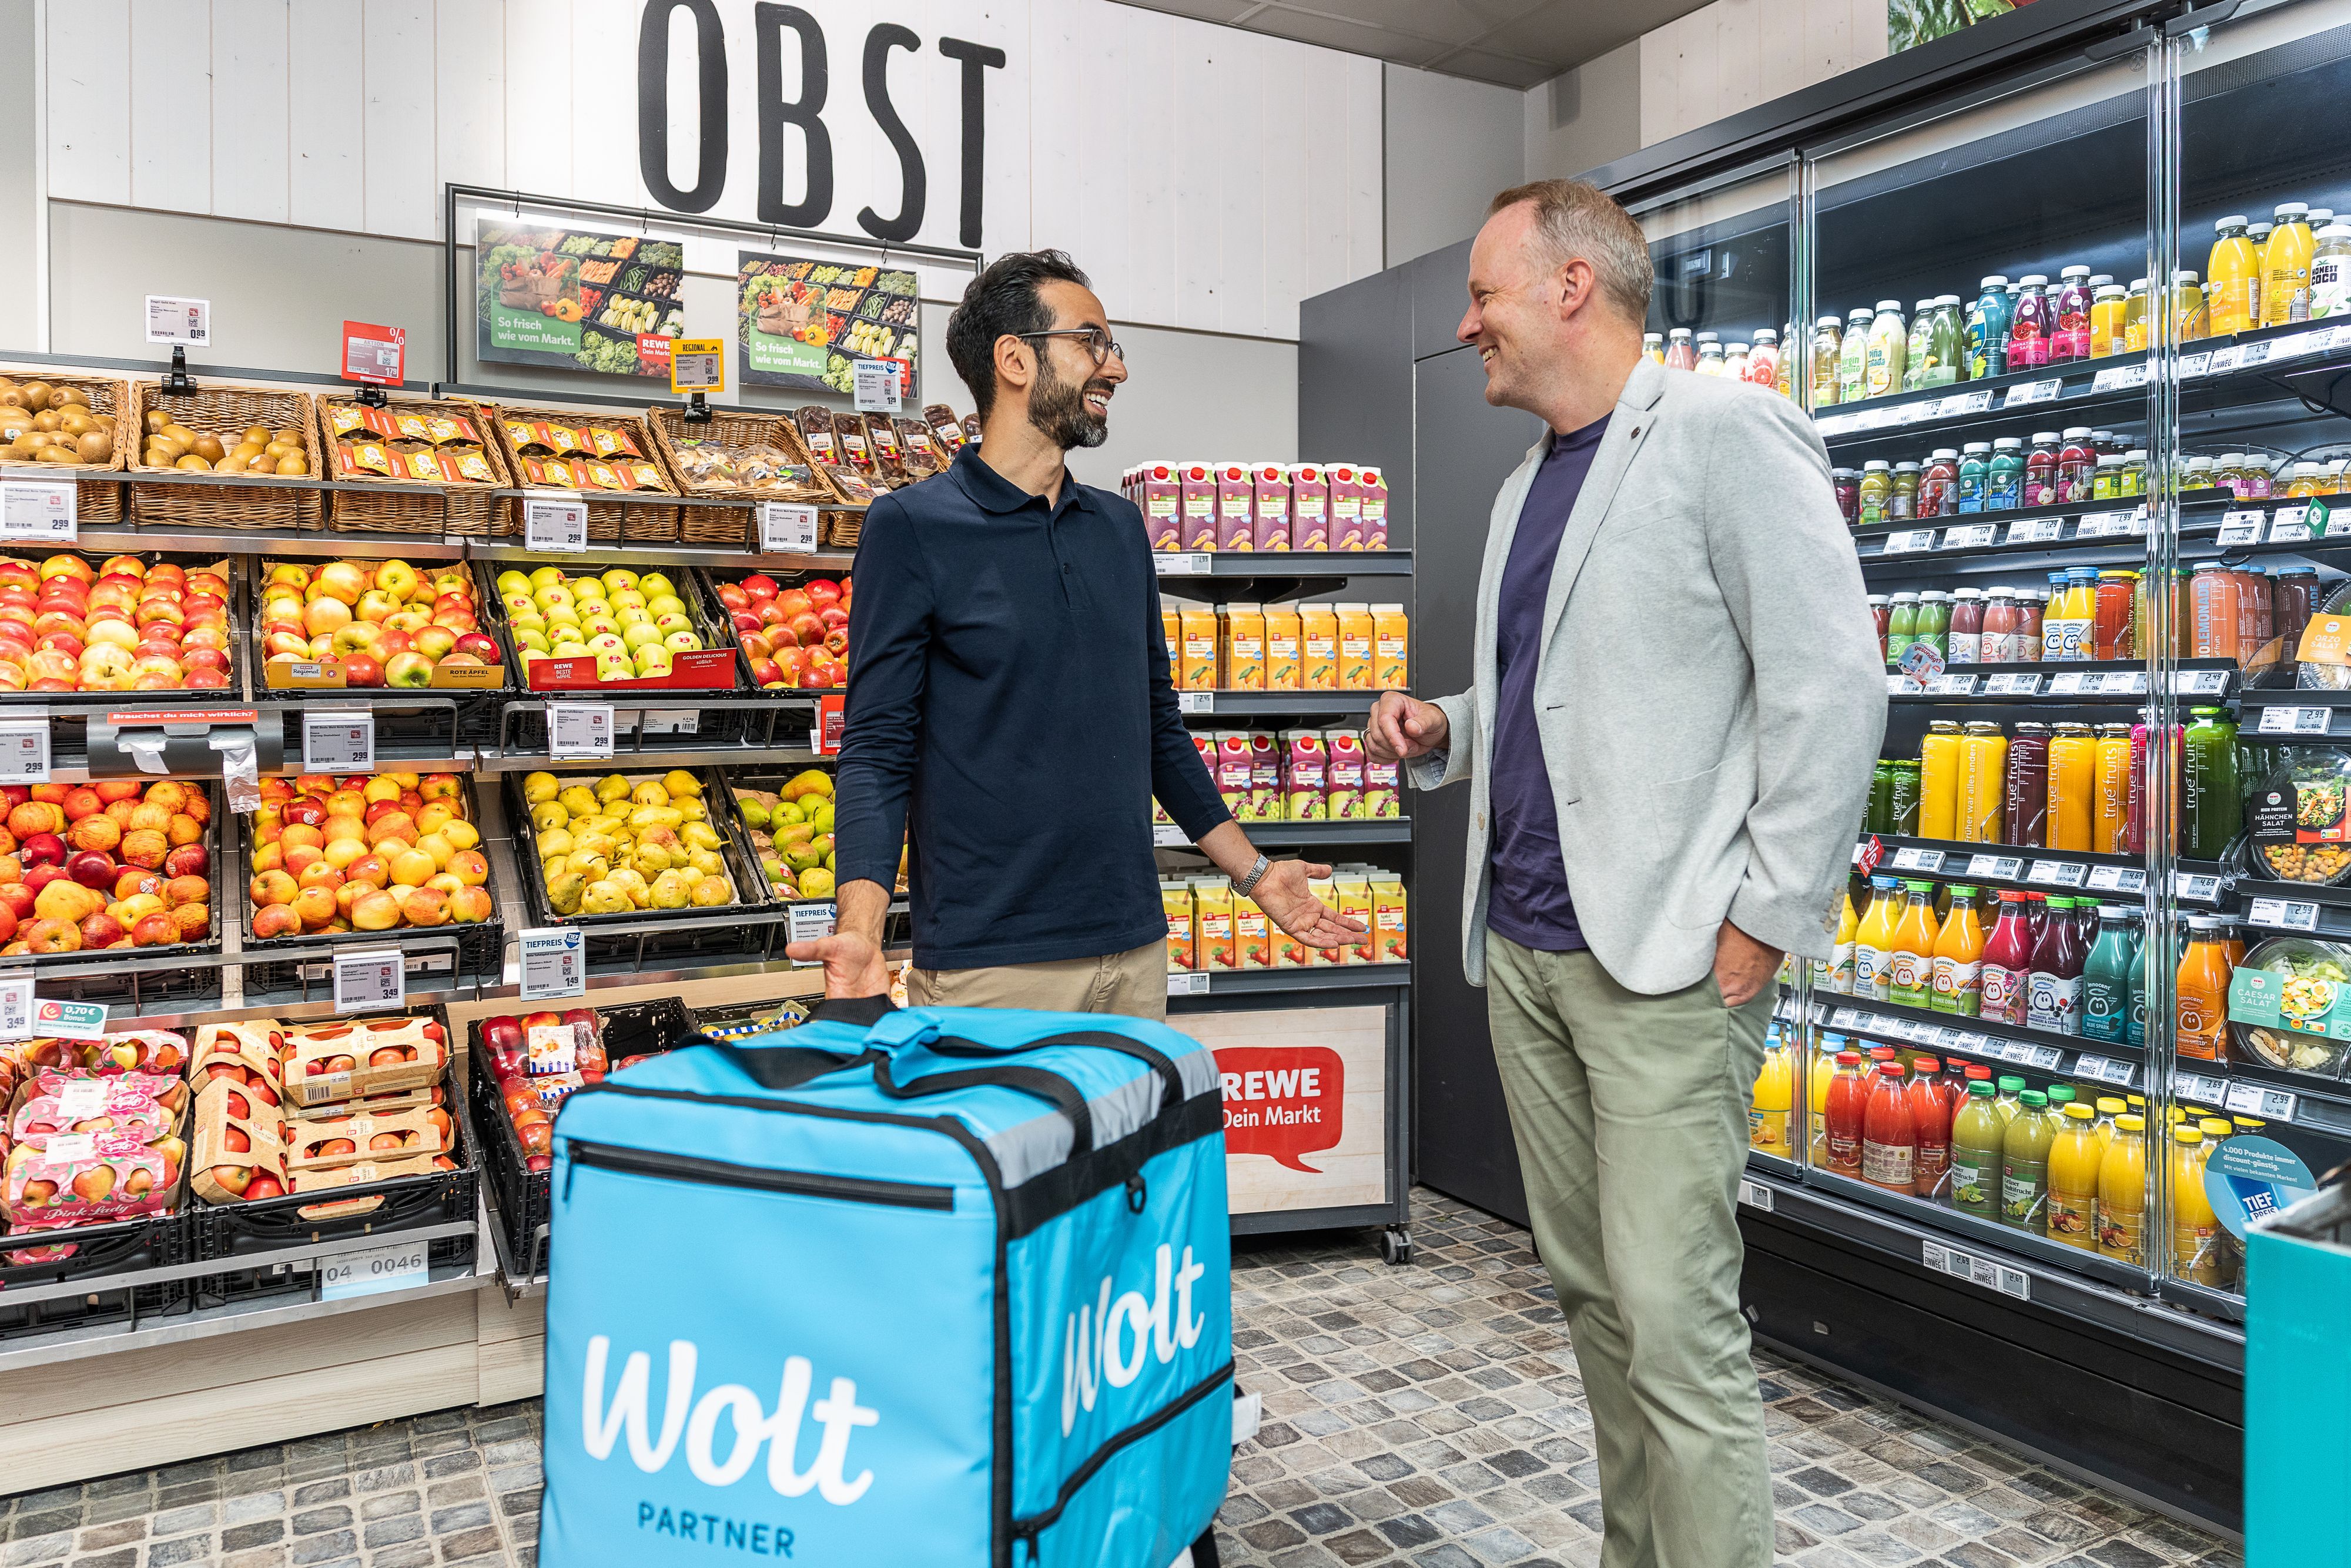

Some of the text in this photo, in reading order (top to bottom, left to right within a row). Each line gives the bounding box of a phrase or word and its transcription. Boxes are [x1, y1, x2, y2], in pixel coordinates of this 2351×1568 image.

[638, 0, 1006, 249] OBST
[2312, 265, 2338, 275] HONEST
[2312, 273, 2337, 286] COCO
[498, 317, 542, 330] So frisch
[190, 329, 205, 339] 0.89
[498, 330, 574, 346] wie vom Markt.
[642, 339, 671, 349] REWE
[755, 341, 793, 354] So frisch
[2256, 343, 2270, 353] 1.79
[1868, 349, 1882, 361] Piña
[755, 354, 822, 368] wie vom Markt.
[2212, 359, 2232, 370] EINWEG
[1841, 366, 1860, 375] Mojito
[2093, 382, 2111, 392] EINWEG
[2119, 514, 2131, 522] 1.99
[52, 519, 69, 530] 2.99
[568, 534, 581, 543] 2.99
[801, 535, 812, 544] 2.99
[2310, 641, 2340, 649] SALAT
[2307, 710, 2324, 720] 2.99
[595, 737, 608, 747] 2.99
[353, 752, 367, 762] 2.99
[26, 763, 42, 773] 2.99
[2185, 735, 2196, 809] true fruits
[2008, 745, 2018, 812] true fruits
[2048, 745, 2058, 814] true fruits
[2103, 747, 2117, 818] true fruits
[1859, 857, 1871, 875] Aktion
[2201, 879, 2216, 887] 4.69
[526, 939, 562, 948] TIEFPREIS
[565, 977, 578, 987] 1.49
[2034, 976, 2056, 984] innocent
[2088, 982, 2112, 991] innocent
[383, 989, 398, 999] 3.49
[2178, 995, 2205, 1004] innocent
[2238, 989, 2276, 1000] CAESAR
[2240, 997, 2271, 1007] SALAT
[65, 1006, 88, 1015] 0,70
[7, 1017, 25, 1028] 3.49
[2005, 1051, 2023, 1061] EINWEG
[2077, 1064, 2095, 1075] EINWEG
[1220, 1068, 1321, 1101] REWE
[2206, 1080, 2222, 1088] 3.69
[2272, 1094, 2289, 1104] 2.99
[1223, 1104, 1321, 1128] Dein Markt
[2223, 1146, 2296, 1165] 4.000 Produkte immer
[2223, 1155, 2279, 1171] discount-günstig.
[2249, 1167, 2276, 1178] bekannten
[2277, 1174, 2298, 1182] Marken!
[2004, 1177, 2020, 1187] Grüner
[2004, 1185, 2032, 1195] Multifrucht
[2242, 1192, 2272, 1211] TIEF
[43, 1204, 129, 1220] Pink Lady
[371, 1254, 421, 1275] 0046
[1925, 1257, 1941, 1270] EINWEG
[1957, 1255, 1970, 1265] 2.69
[327, 1265, 352, 1281] 04
[1974, 1271, 1992, 1285] EINWEG
[2010, 1273, 2022, 1283] 2.69
[1061, 1244, 1205, 1438] Wolt
[584, 1334, 879, 1506] Wolt
[638, 1502, 794, 1558] PARTNER
